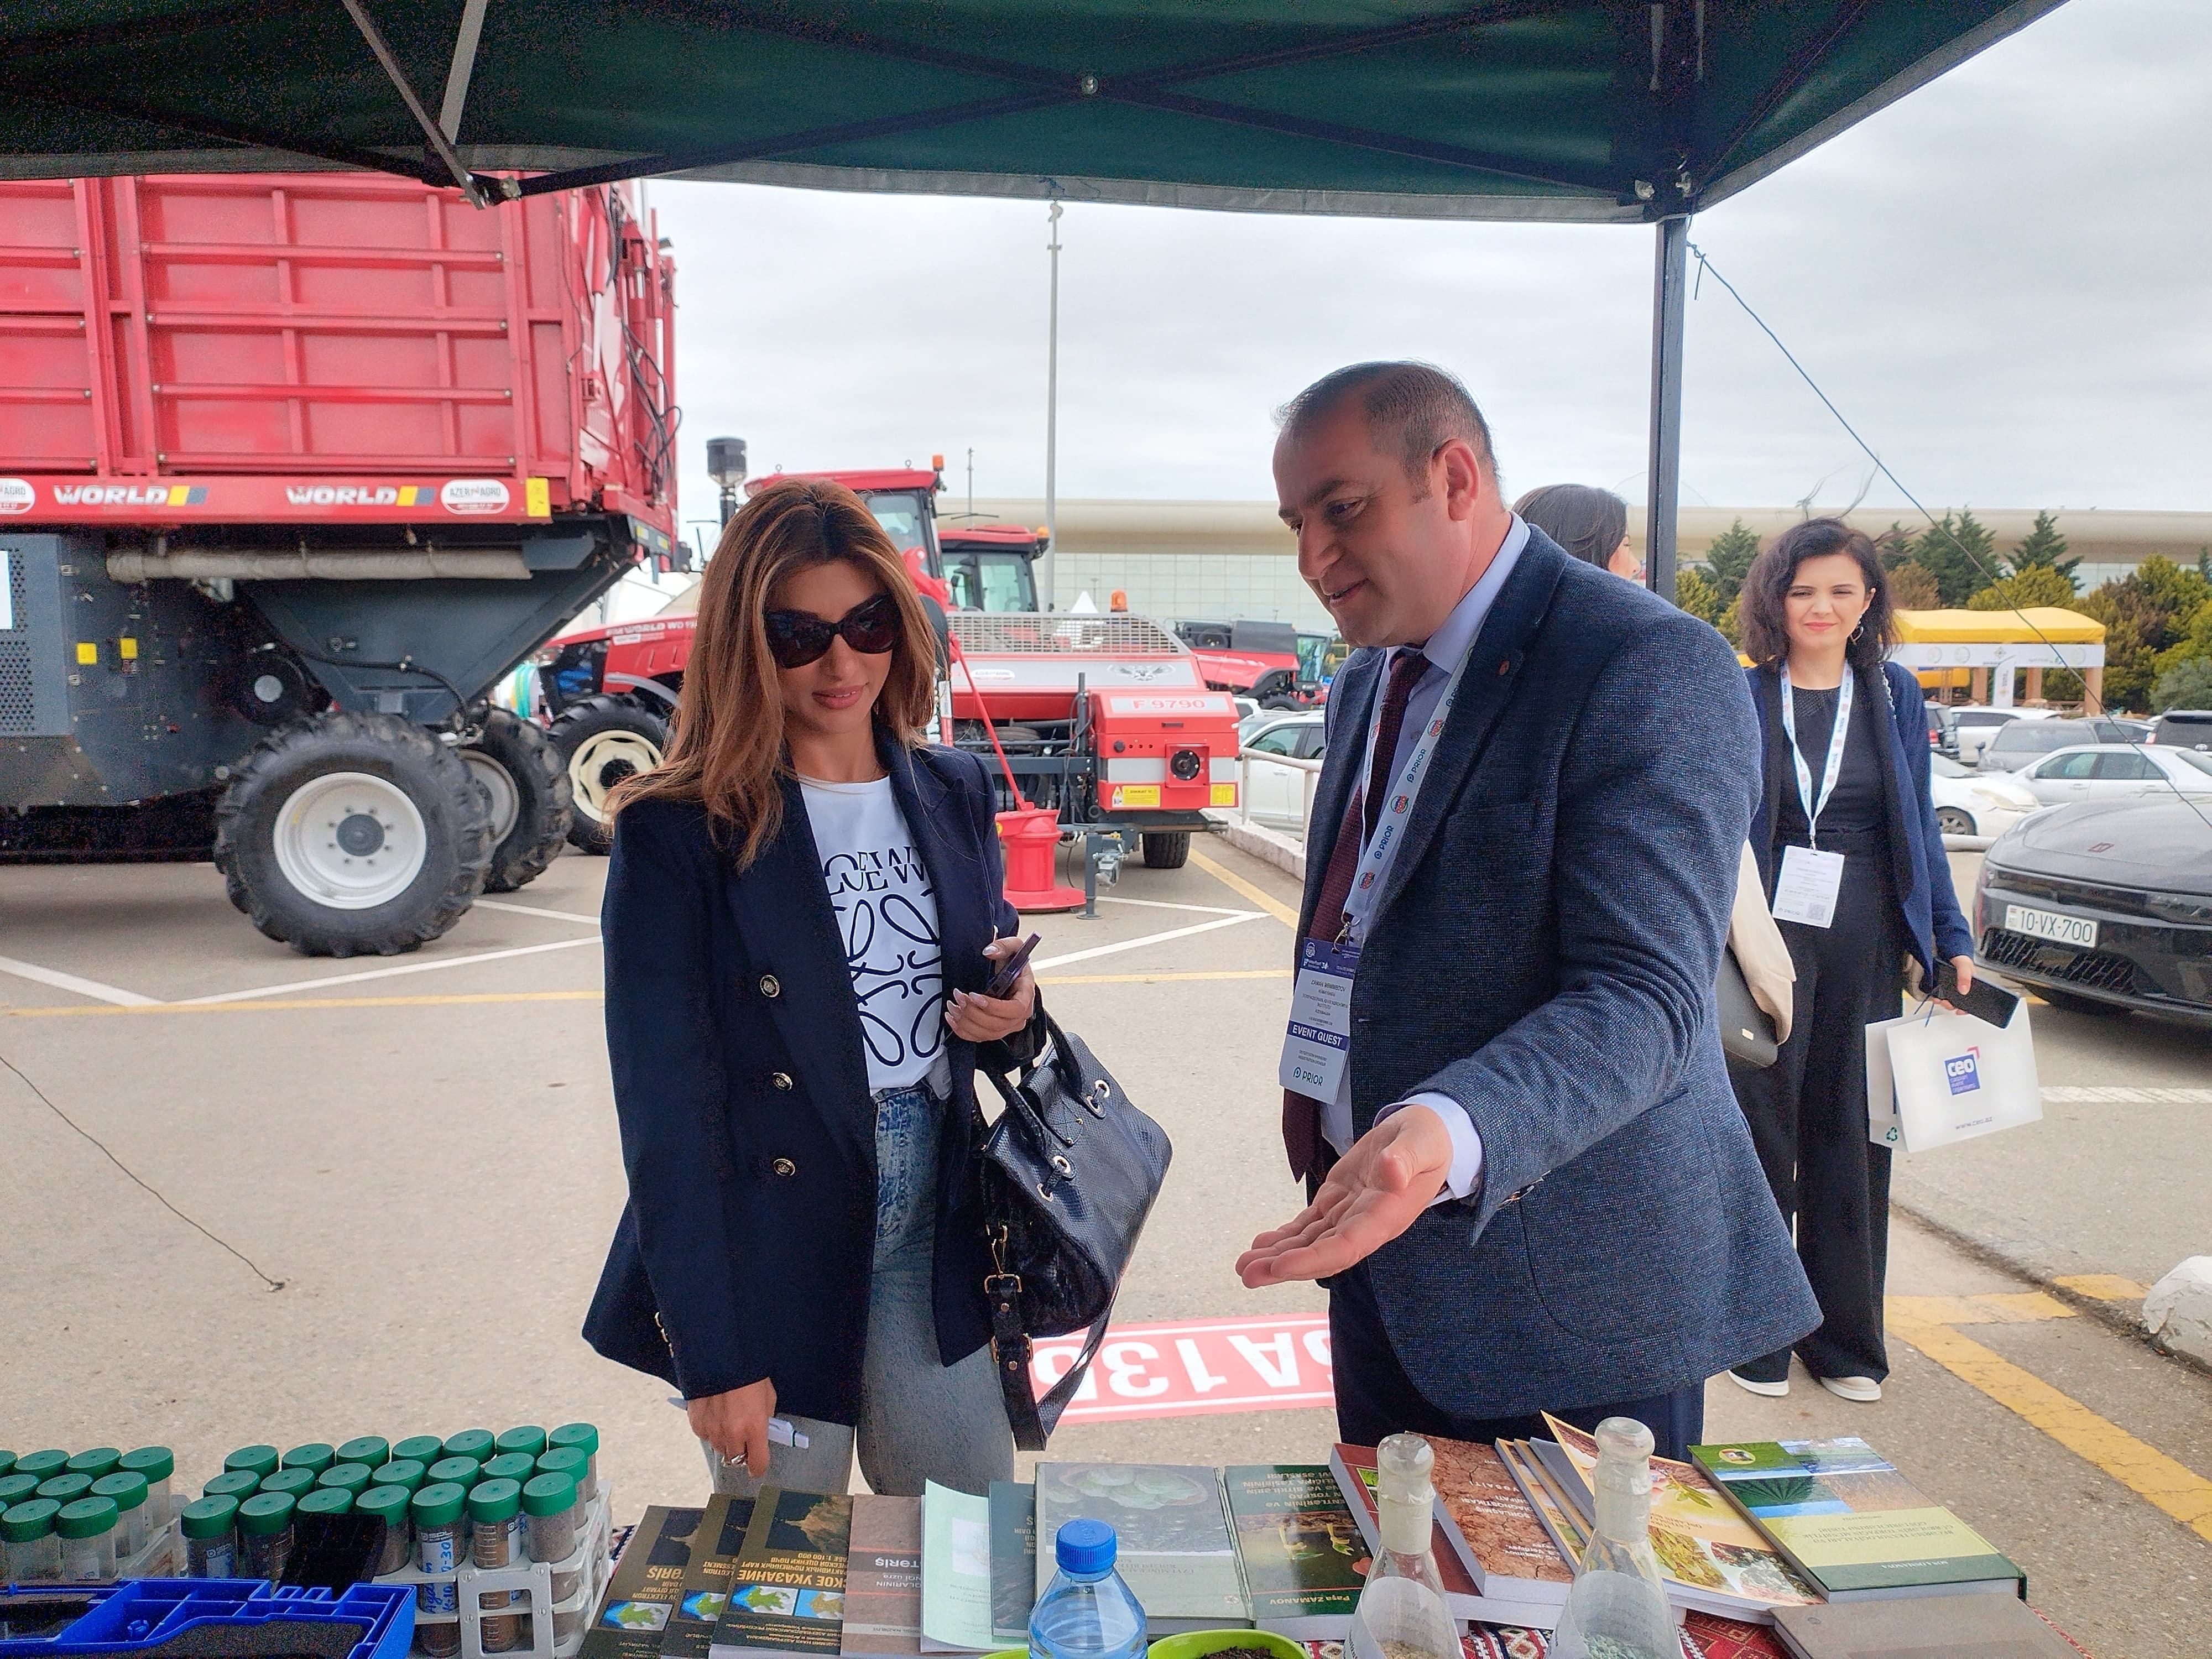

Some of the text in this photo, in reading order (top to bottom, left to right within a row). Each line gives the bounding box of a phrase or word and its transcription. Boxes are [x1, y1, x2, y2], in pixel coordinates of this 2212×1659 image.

[53, 485, 168, 505] WORLD
[285, 486, 397, 505] WORLD
[450, 487, 470, 497] AZER
[1134, 700, 1206, 708] F 9790
[1411, 749, 1427, 773] PRIOR
[1379, 825, 1394, 850] PRIOR
[1292, 1024, 1343, 1047] EVENT GUEST
[1302, 1070, 1323, 1087] PRIOR
[760, 1562, 805, 1572] ПОЧВЕННЫХ
[737, 1569, 812, 1585] УКАЗАНИЕ
[631, 1592, 668, 1600] ELEKTRON
[1269, 1596, 1324, 1604] ZAMANOV
